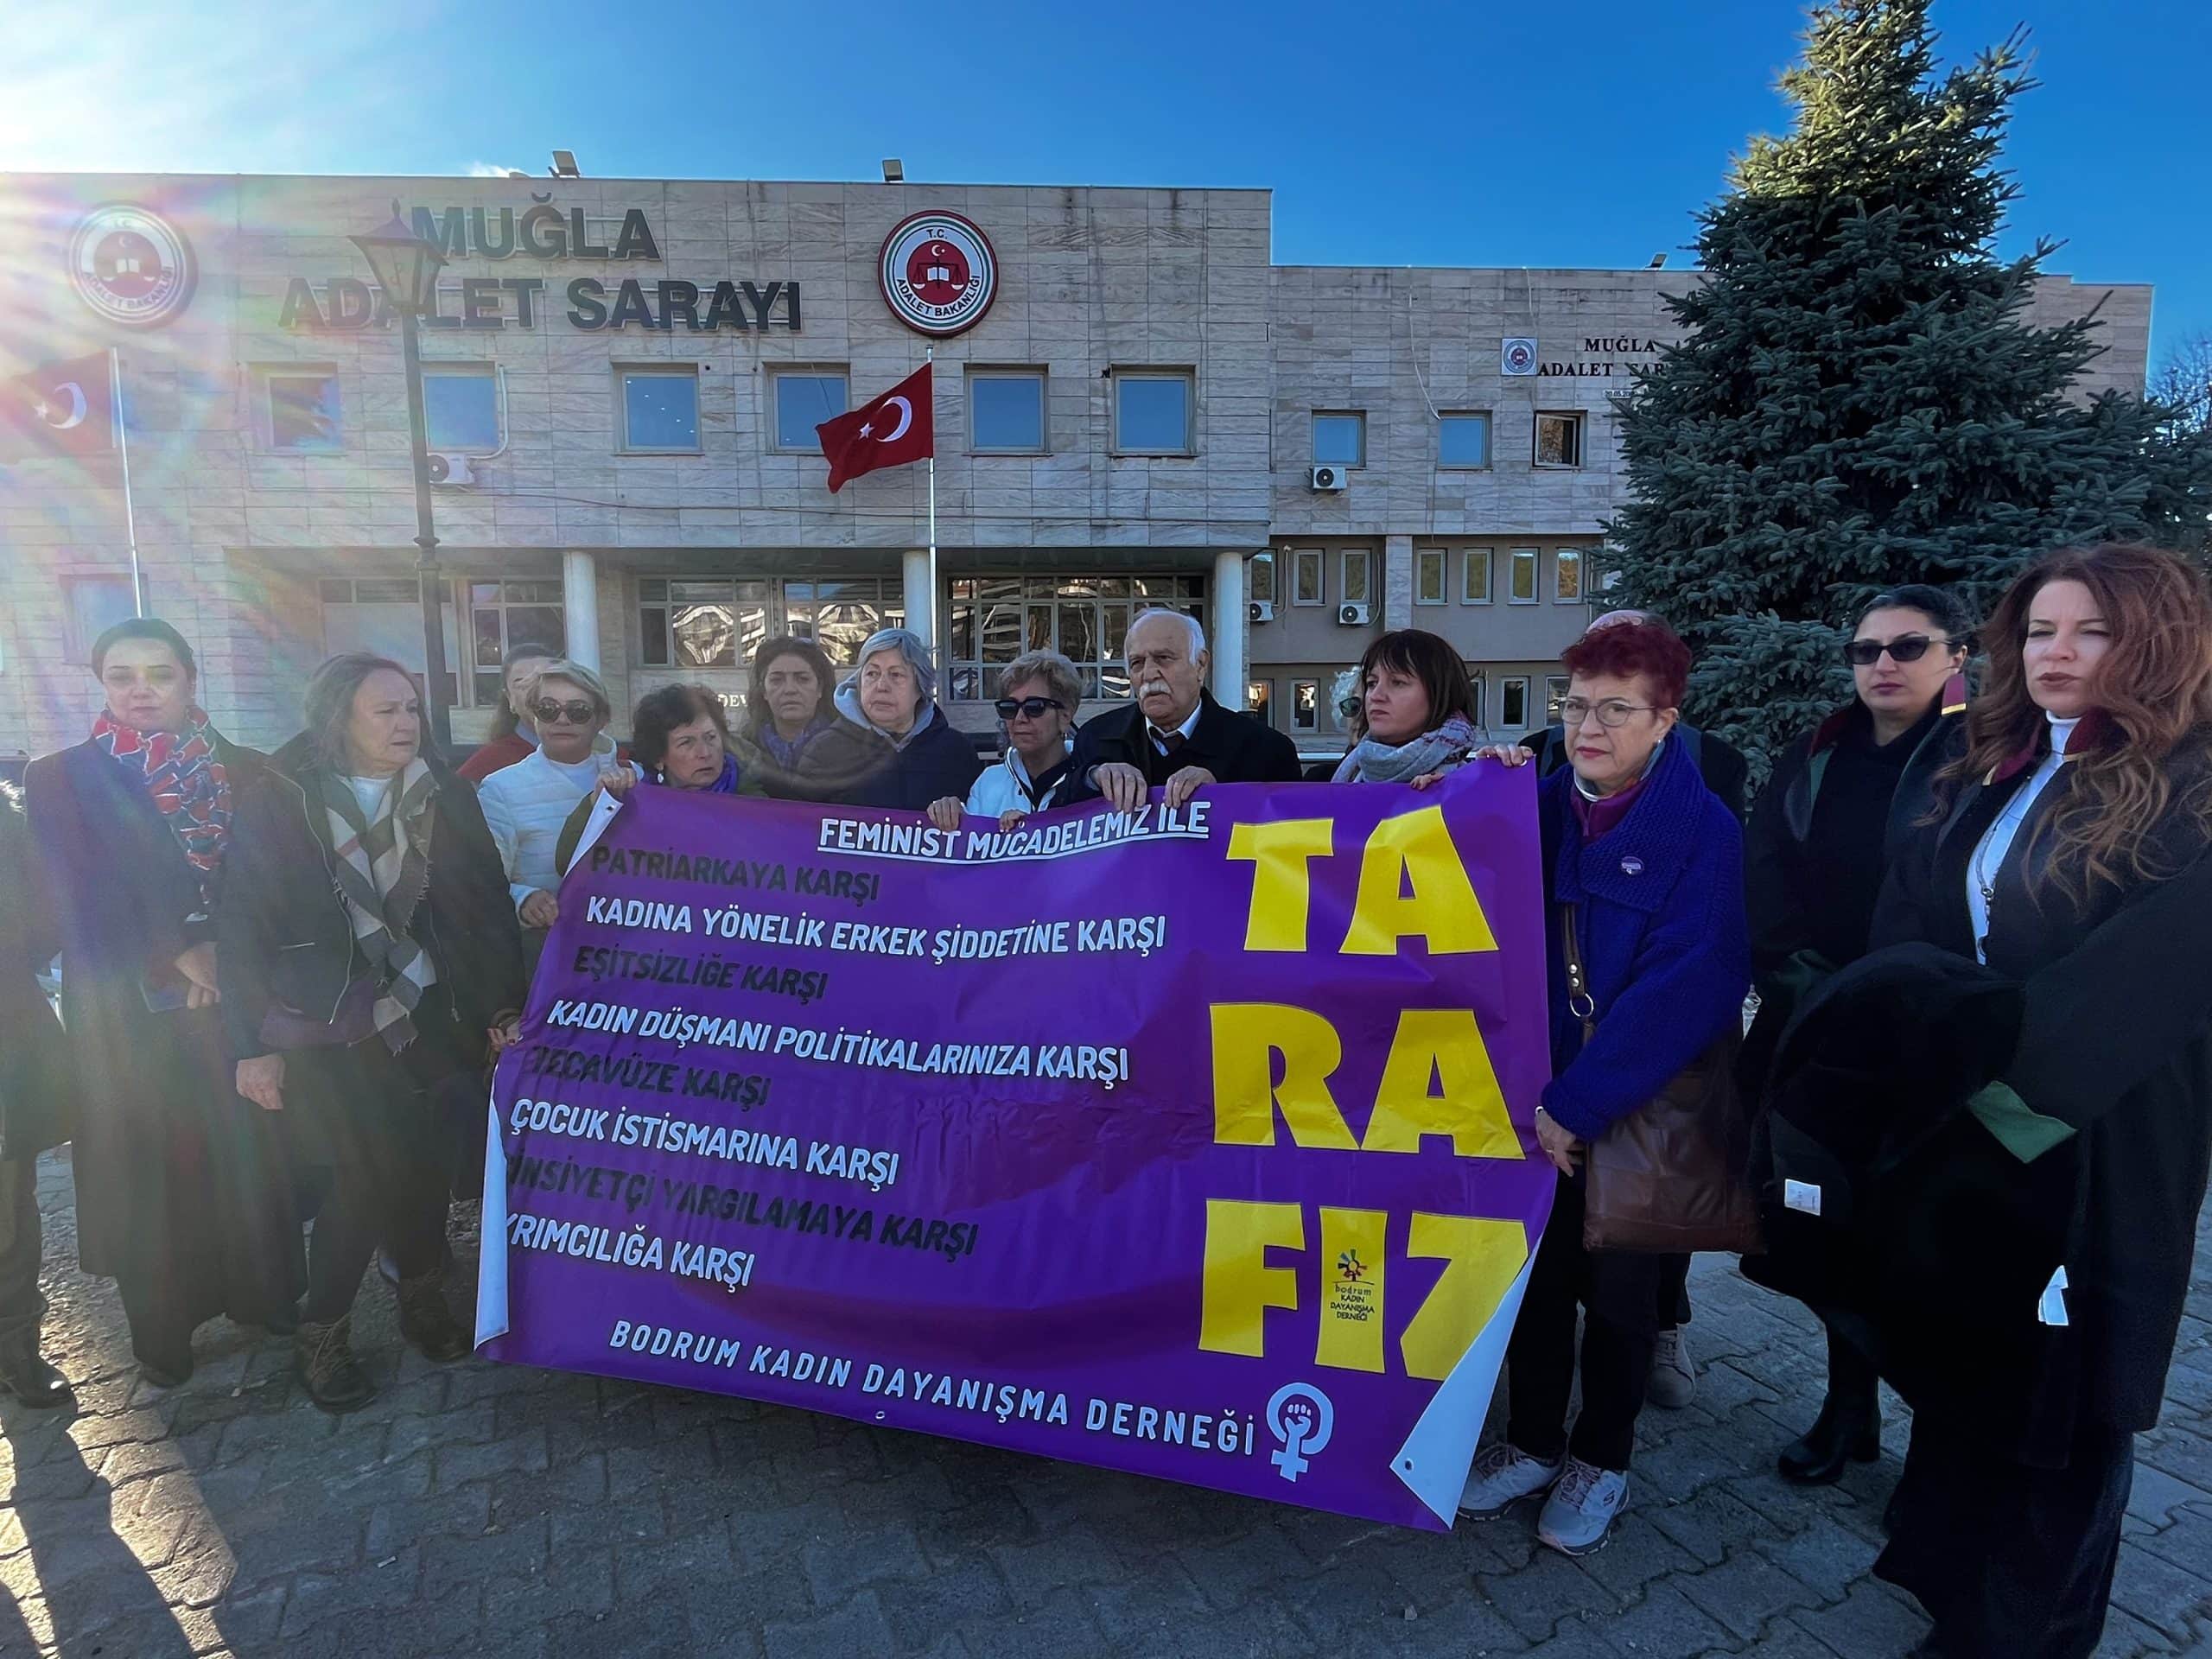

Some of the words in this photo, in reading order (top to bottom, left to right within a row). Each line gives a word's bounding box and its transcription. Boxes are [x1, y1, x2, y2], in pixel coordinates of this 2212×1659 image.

[411, 192, 660, 259] MUĞLA
[926, 229, 948, 239] T.C.
[277, 277, 543, 329] ADLET
[566, 278, 802, 330] SARAYI
[897, 278, 932, 315] ADALET
[1538, 363, 1614, 376] ADALET
[1630, 363, 1667, 376] SAR
[1584, 335, 1656, 352] MUĞLA
[818, 817, 961, 858] FEMİNİST
[591, 846, 787, 891] PATRİARKAYA
[795, 868, 880, 907] KARŞI
[1225, 804, 1500, 956] TA
[587, 896, 692, 933] KADINA
[703, 904, 825, 948] YÖNELİK
[830, 922, 927, 957] ERKEK
[931, 918, 1070, 965] ŞİDDETİNE
[1077, 916, 1166, 957] KARŞI
[574, 943, 733, 988] EŞİTSİZLİĞE
[741, 961, 829, 1005] KARŞI
[547, 1000, 639, 1034] KADIN
[639, 1006, 771, 1052] DÜŞMANI
[774, 1026, 1031, 1076] POLİTİKALARINIZA
[1036, 1045, 1128, 1090] KARŞI
[682, 1067, 772, 1112] KARŞI
[1209, 1002, 1527, 1160] RA
[510, 1098, 609, 1141] ÇOCUK
[611, 1105, 798, 1170] İSTİSMARINA
[806, 1141, 899, 1192] KARŞI
[507, 1147, 655, 1213] İNSİYETÇİ
[664, 1177, 873, 1242] YARGILAMAYA
[878, 1213, 979, 1262] KARŞI
[670, 1240, 756, 1294] KARŞI
[1335, 1284, 1372, 1295] bodrum
[1341, 1294, 1365, 1303] KADIN
[608, 1319, 741, 1368] BODRUM
[748, 1344, 853, 1388] KADIN
[861, 1363, 1070, 1426] DAYANIŞMA
[1085, 1398, 1255, 1456] DERNEĞİ
